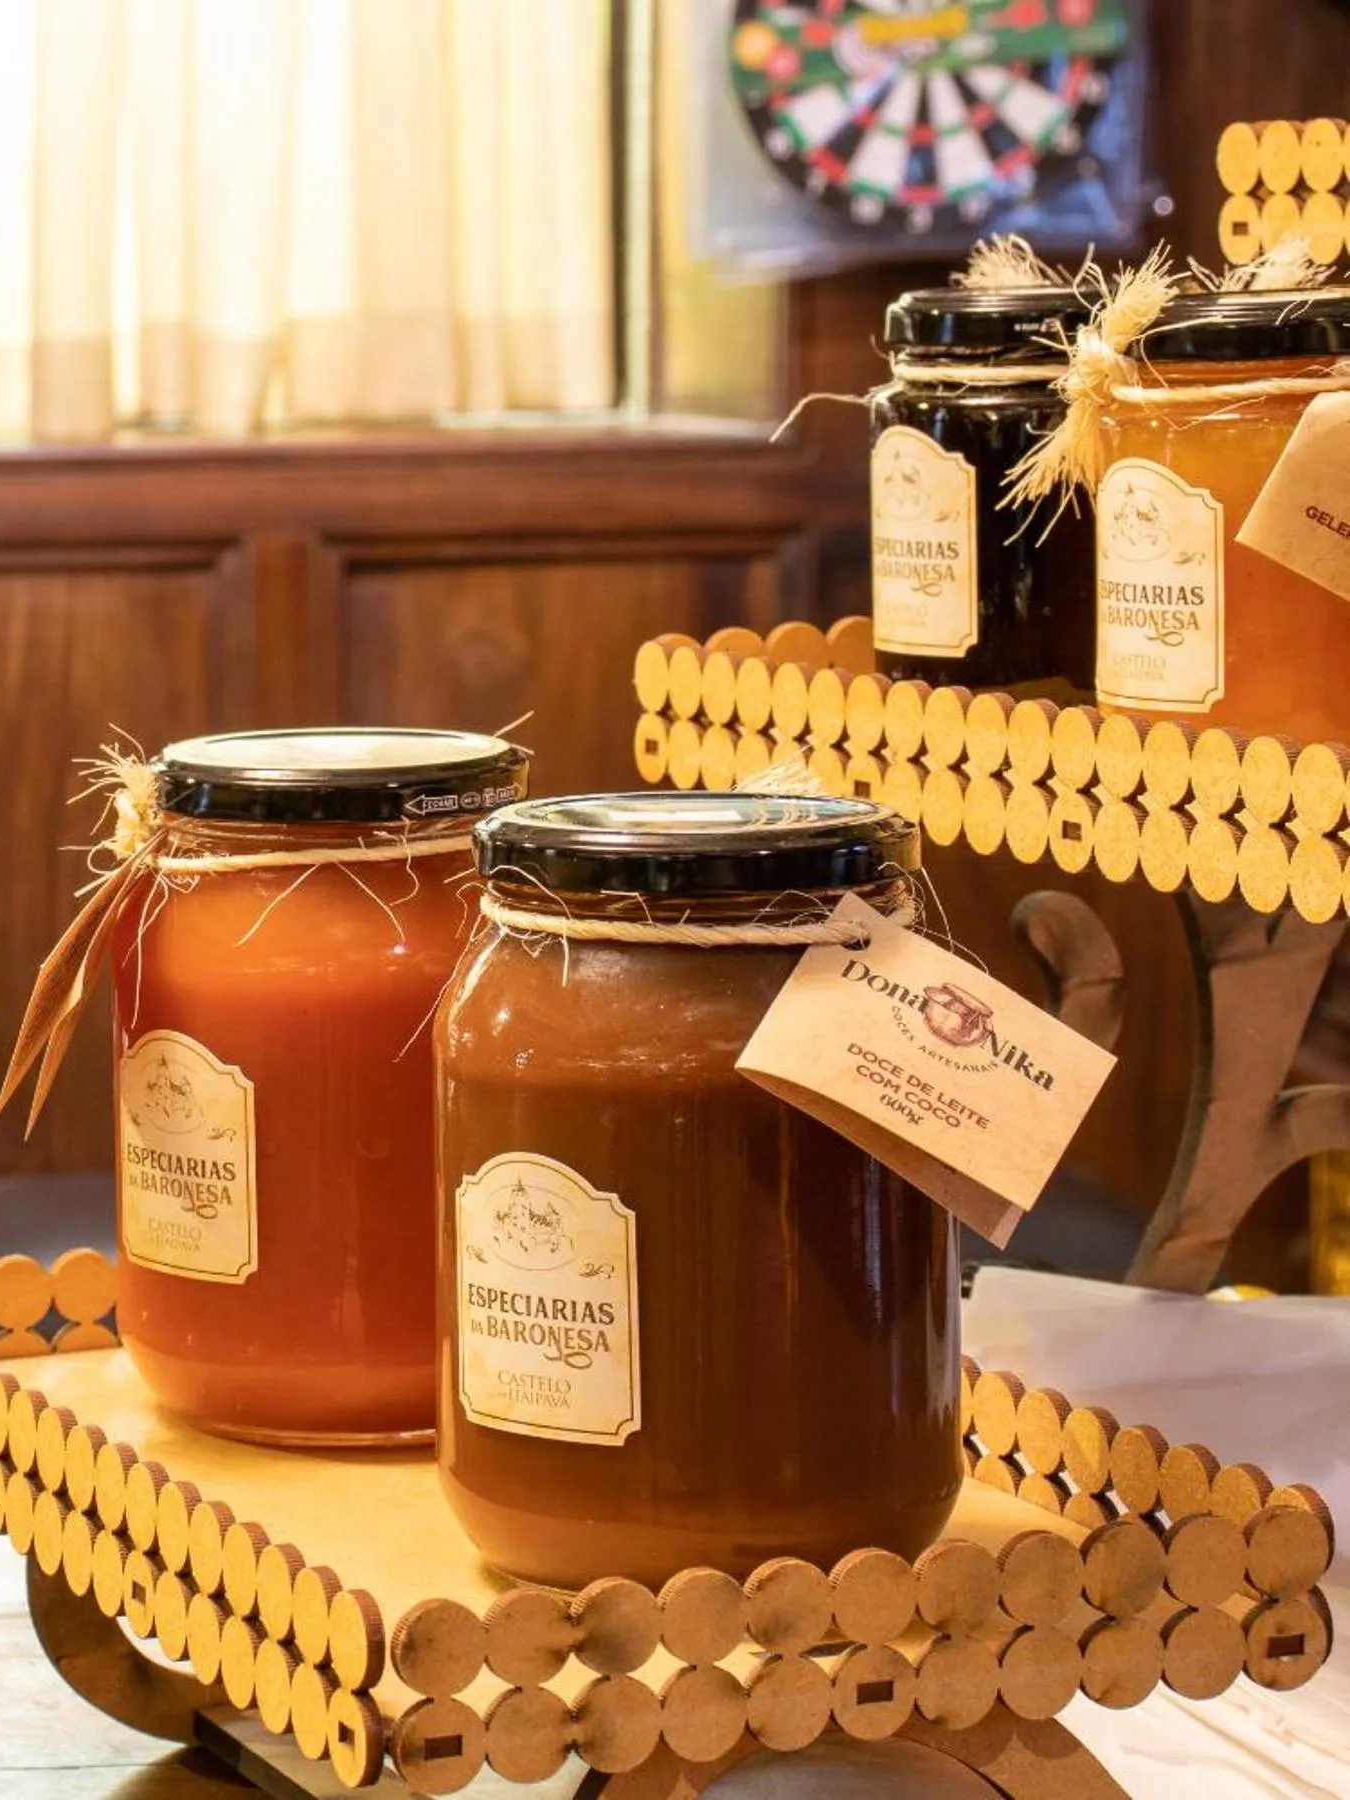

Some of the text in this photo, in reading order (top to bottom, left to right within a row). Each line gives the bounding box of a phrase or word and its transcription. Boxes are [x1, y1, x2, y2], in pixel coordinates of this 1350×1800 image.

[1107, 604, 1200, 647] BARONESA
[841, 959, 1055, 1091] Dona Nika
[847, 1042, 990, 1129] DOCE DE LEITE
[856, 1064, 962, 1128] COM COCO
[127, 1142, 236, 1182] ESPECIARIAS
[140, 1171, 233, 1219] BARONESA
[468, 1283, 615, 1326] ESPECIARIAS
[470, 1315, 611, 1369] DA BARONESA
[497, 1370, 571, 1394] CASTELO
